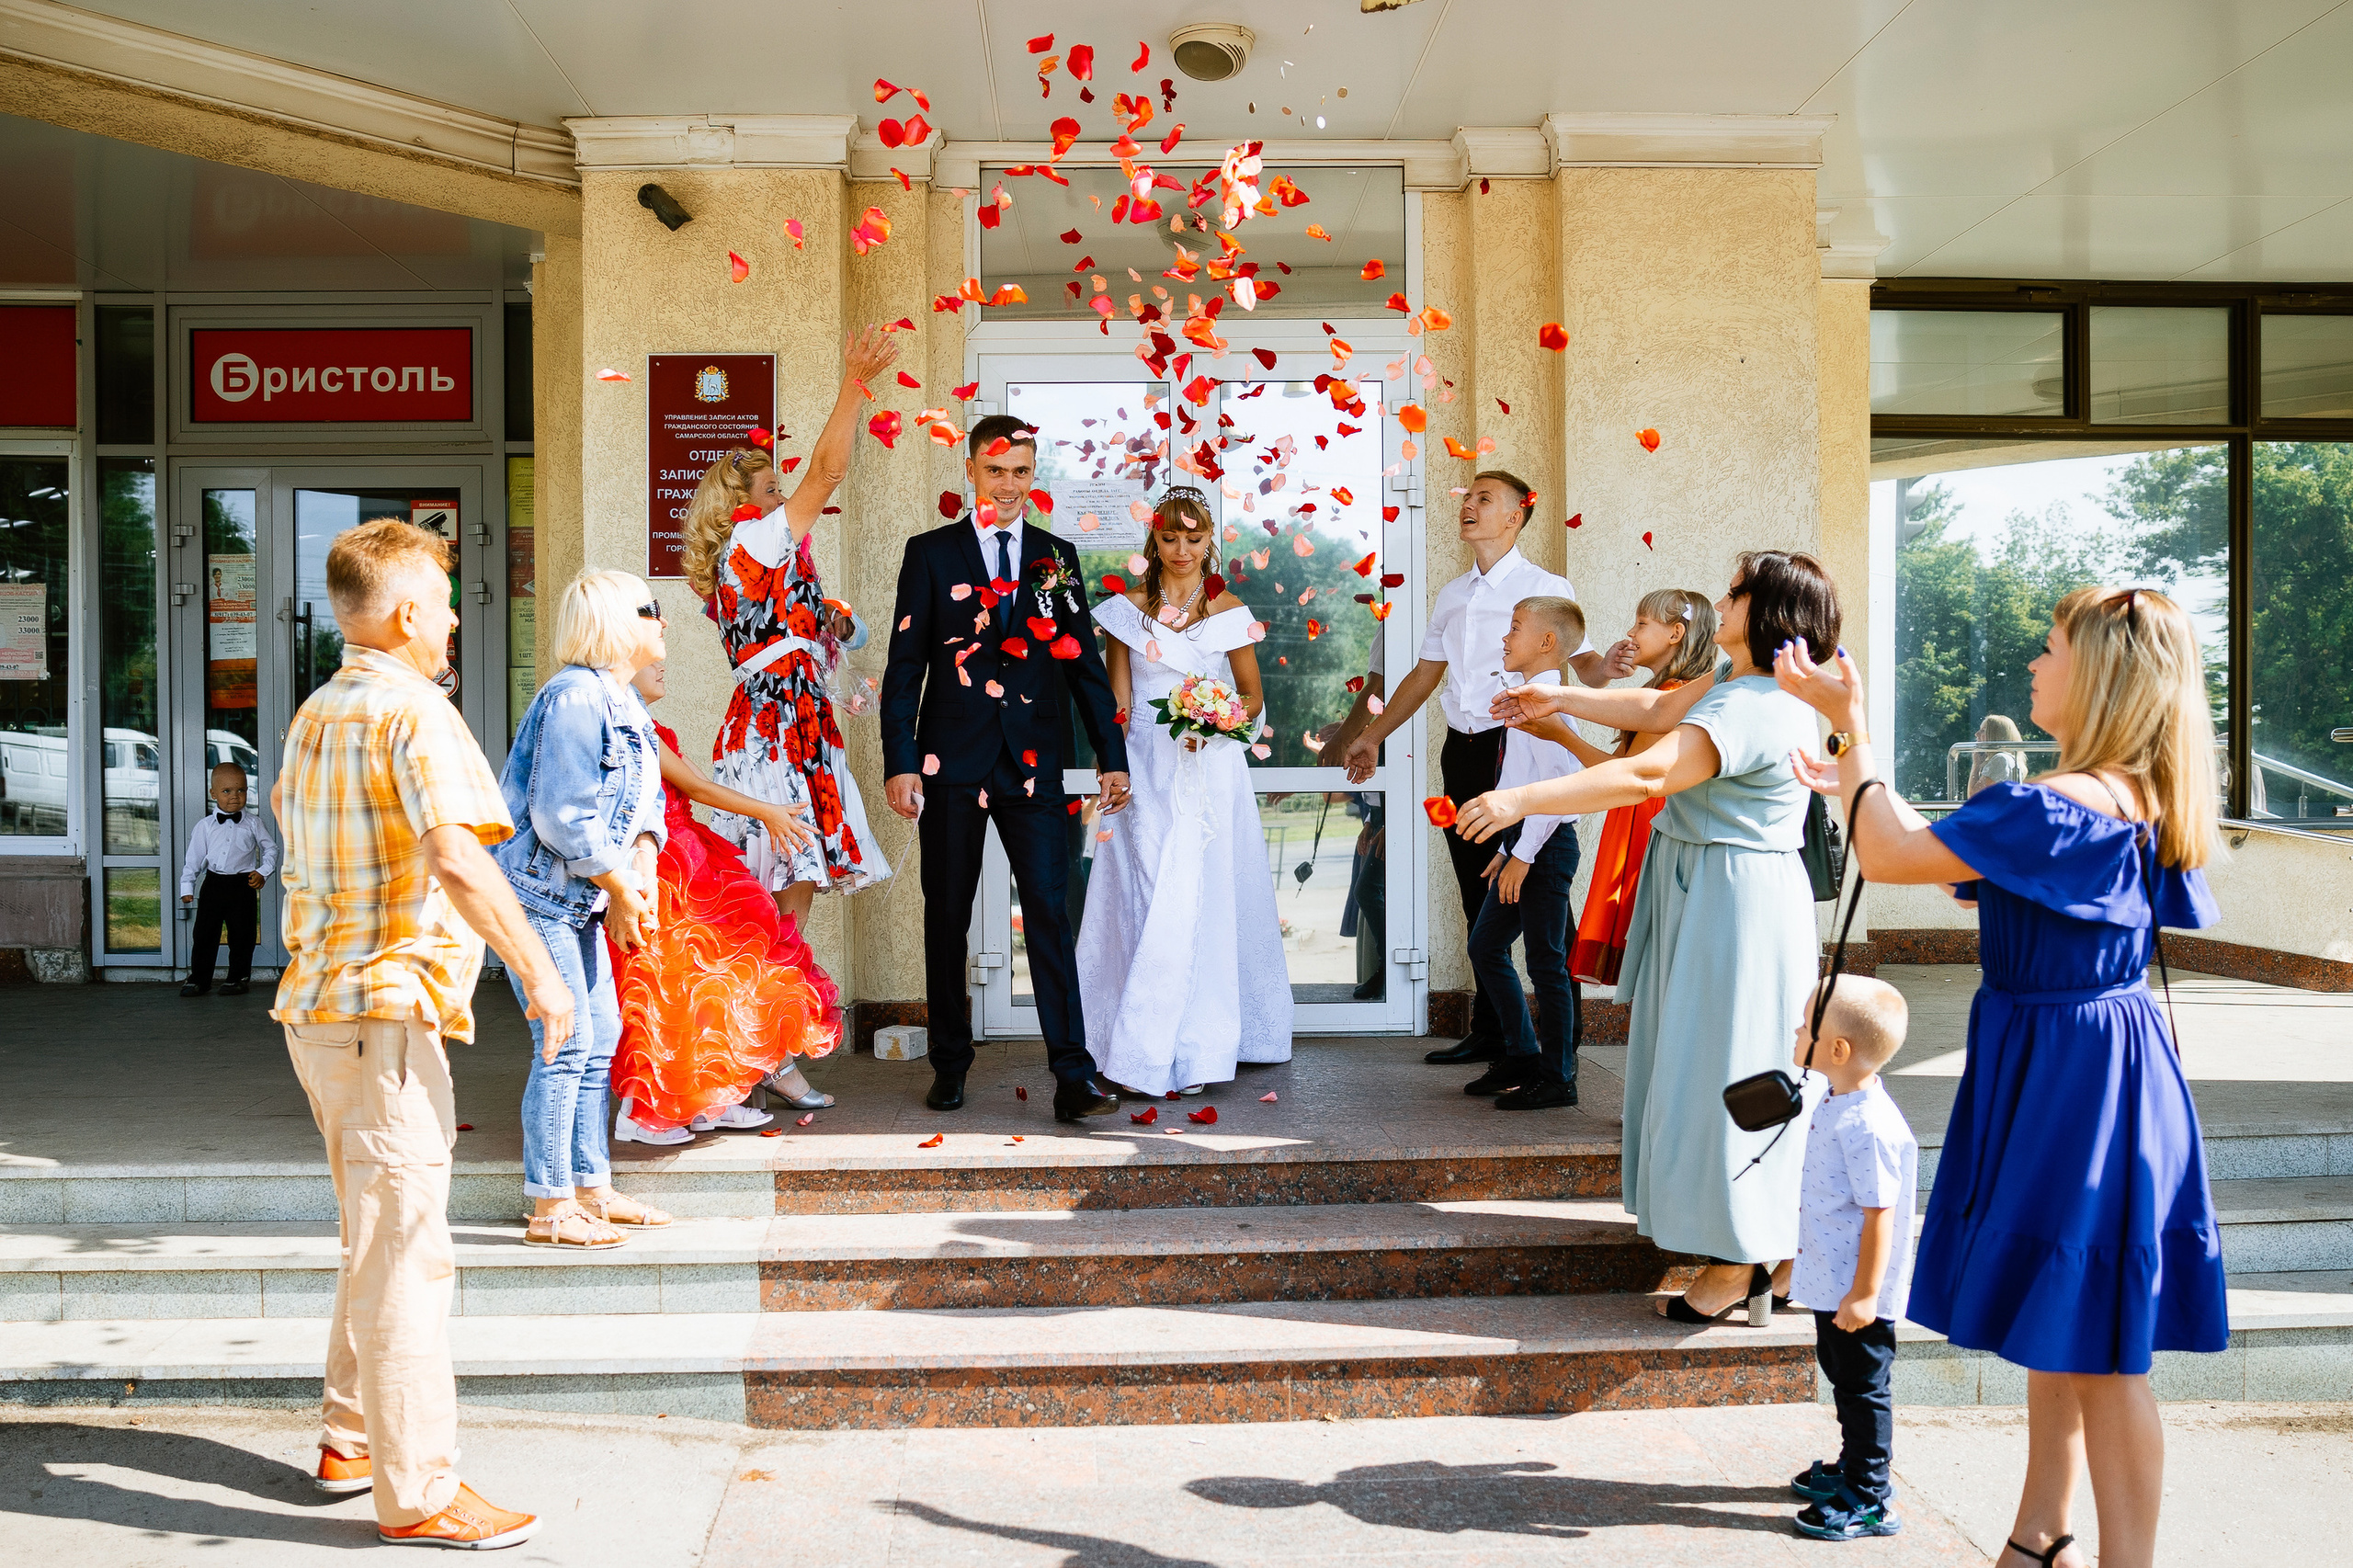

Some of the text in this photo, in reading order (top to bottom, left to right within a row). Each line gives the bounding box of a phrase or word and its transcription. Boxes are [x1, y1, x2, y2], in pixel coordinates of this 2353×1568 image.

[213, 355, 455, 402] Бристоль
[659, 469, 708, 481] ЗАПИС
[669, 507, 693, 519] СО
[652, 531, 686, 540] ПРОМЫ
